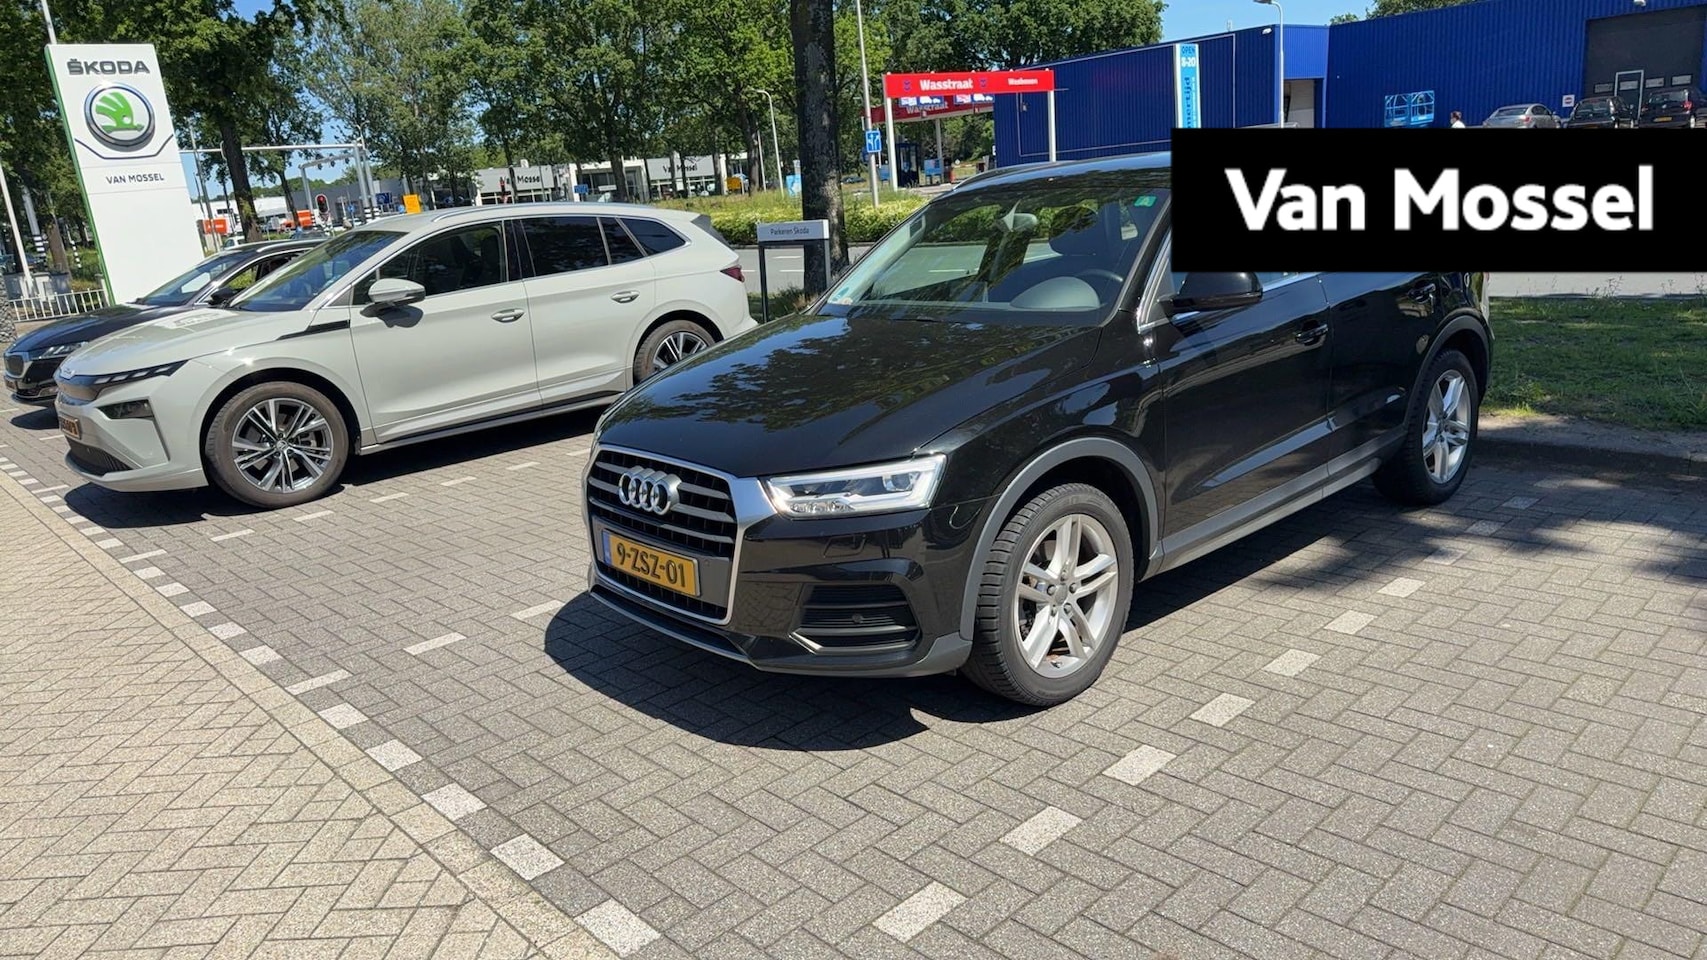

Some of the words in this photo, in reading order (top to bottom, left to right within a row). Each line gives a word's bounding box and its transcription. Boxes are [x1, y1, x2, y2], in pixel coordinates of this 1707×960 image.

[67, 58, 151, 75] ŠKODA
[920, 78, 974, 91] Wasstraat
[106, 175, 126, 184] VAN
[128, 173, 164, 183] MOSSEL
[517, 175, 542, 184] Mosse
[617, 542, 686, 588] 9-ZSZ-01
